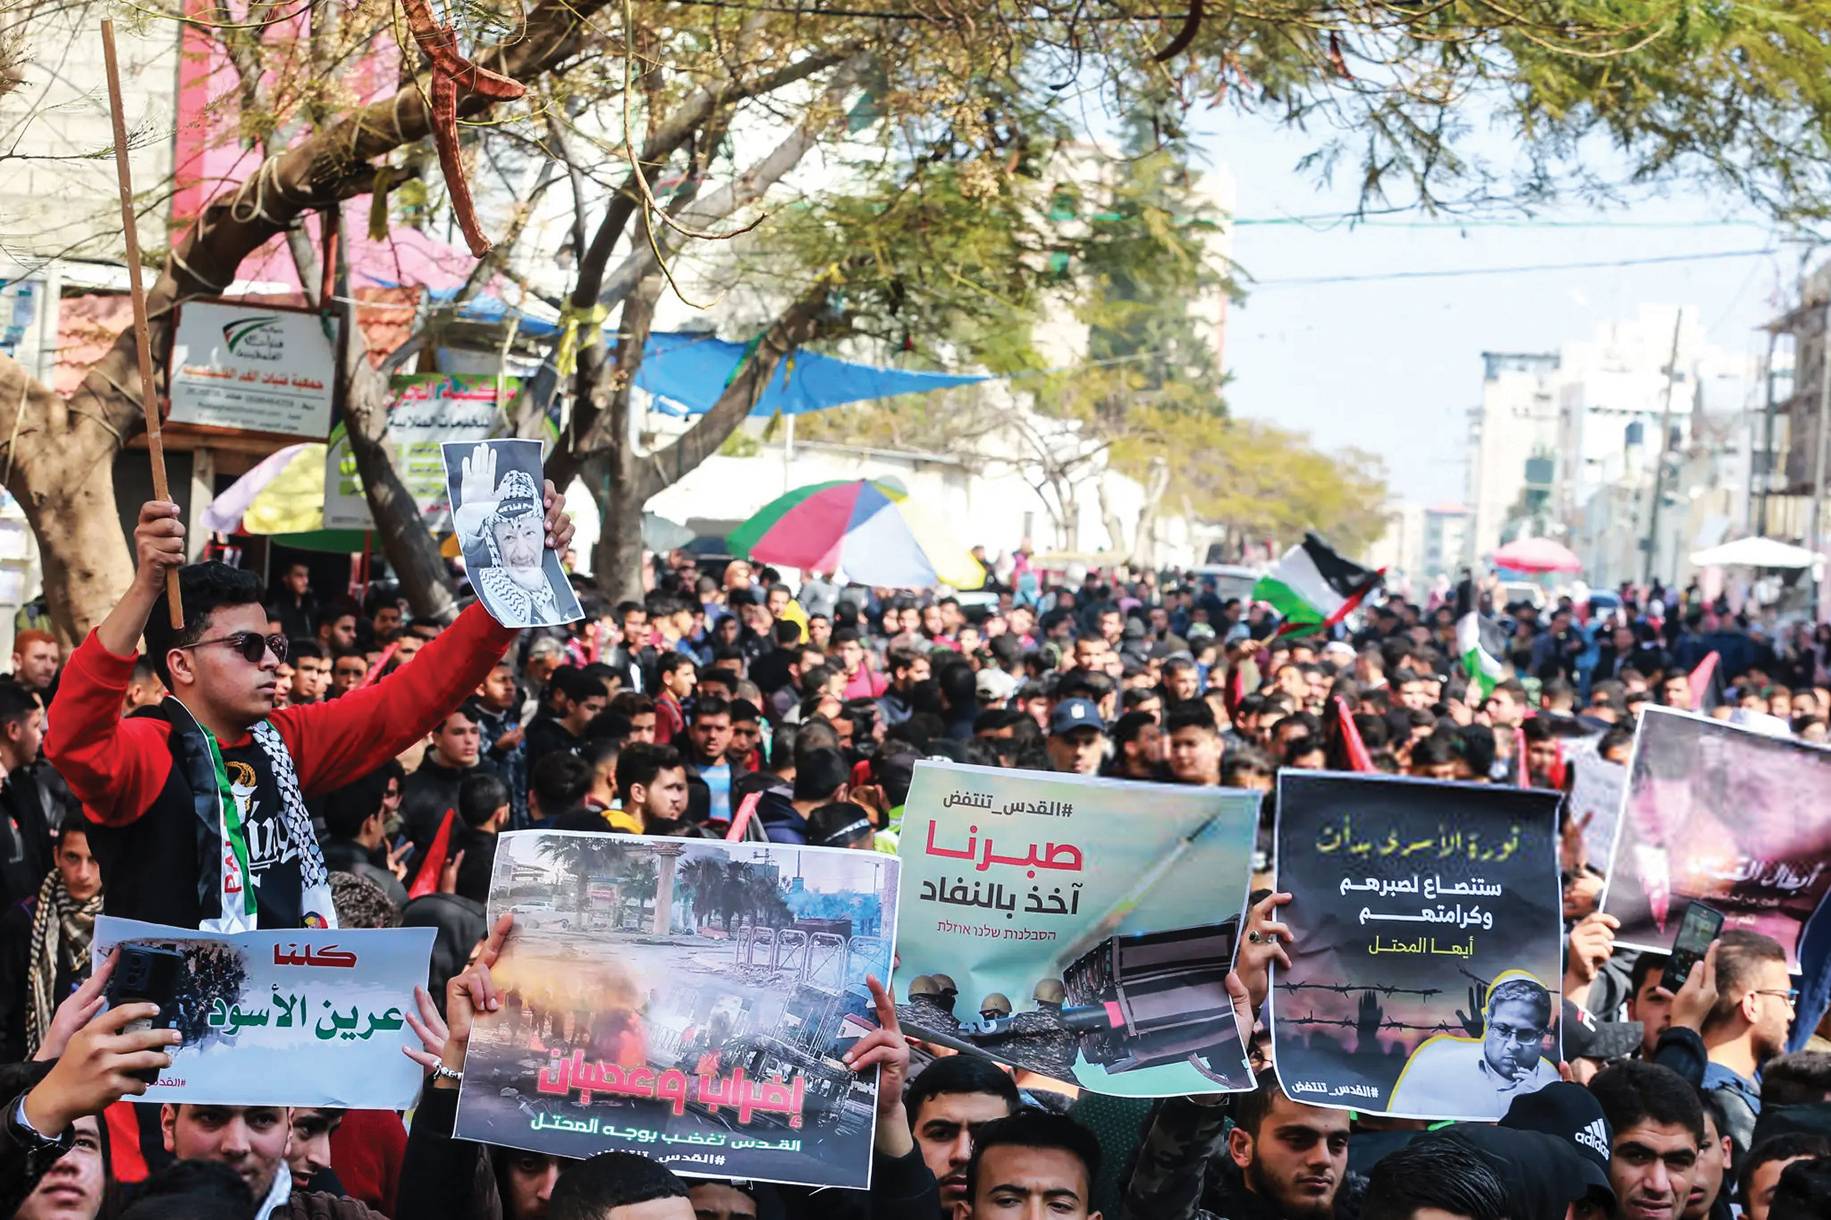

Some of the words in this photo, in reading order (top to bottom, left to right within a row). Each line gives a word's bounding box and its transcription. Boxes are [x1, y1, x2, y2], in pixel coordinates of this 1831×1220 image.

[943, 790, 1073, 818] #القدس_تنتفض
[925, 819, 1082, 879] صبرنا
[1340, 874, 1419, 897] لصبرهم
[1423, 875, 1502, 899] ستنصاع
[919, 876, 1017, 920] بالنفاد
[1024, 882, 1083, 915] آخذ
[937, 920, 971, 936] אוזלת
[1359, 904, 1493, 930] وكرامتهم
[974, 924, 1001, 940] שלנו
[1003, 927, 1056, 941] הסבלנות
[273, 943, 358, 968] كلنا
[1368, 935, 1427, 955] المحتل
[1431, 935, 1475, 958] أيها
[207, 983, 307, 1036] الأسود
[314, 999, 404, 1041] عرين
[698, 1066, 806, 1128] إضراب
[1291, 1081, 1379, 1099] #القدس_تنتفض
[530, 1112, 598, 1135] المحتل
[602, 1123, 657, 1143] بوجه
[661, 1131, 726, 1147] تغضب
[731, 1137, 801, 1152] القدس
[1574, 1132, 1610, 1161] adidas
